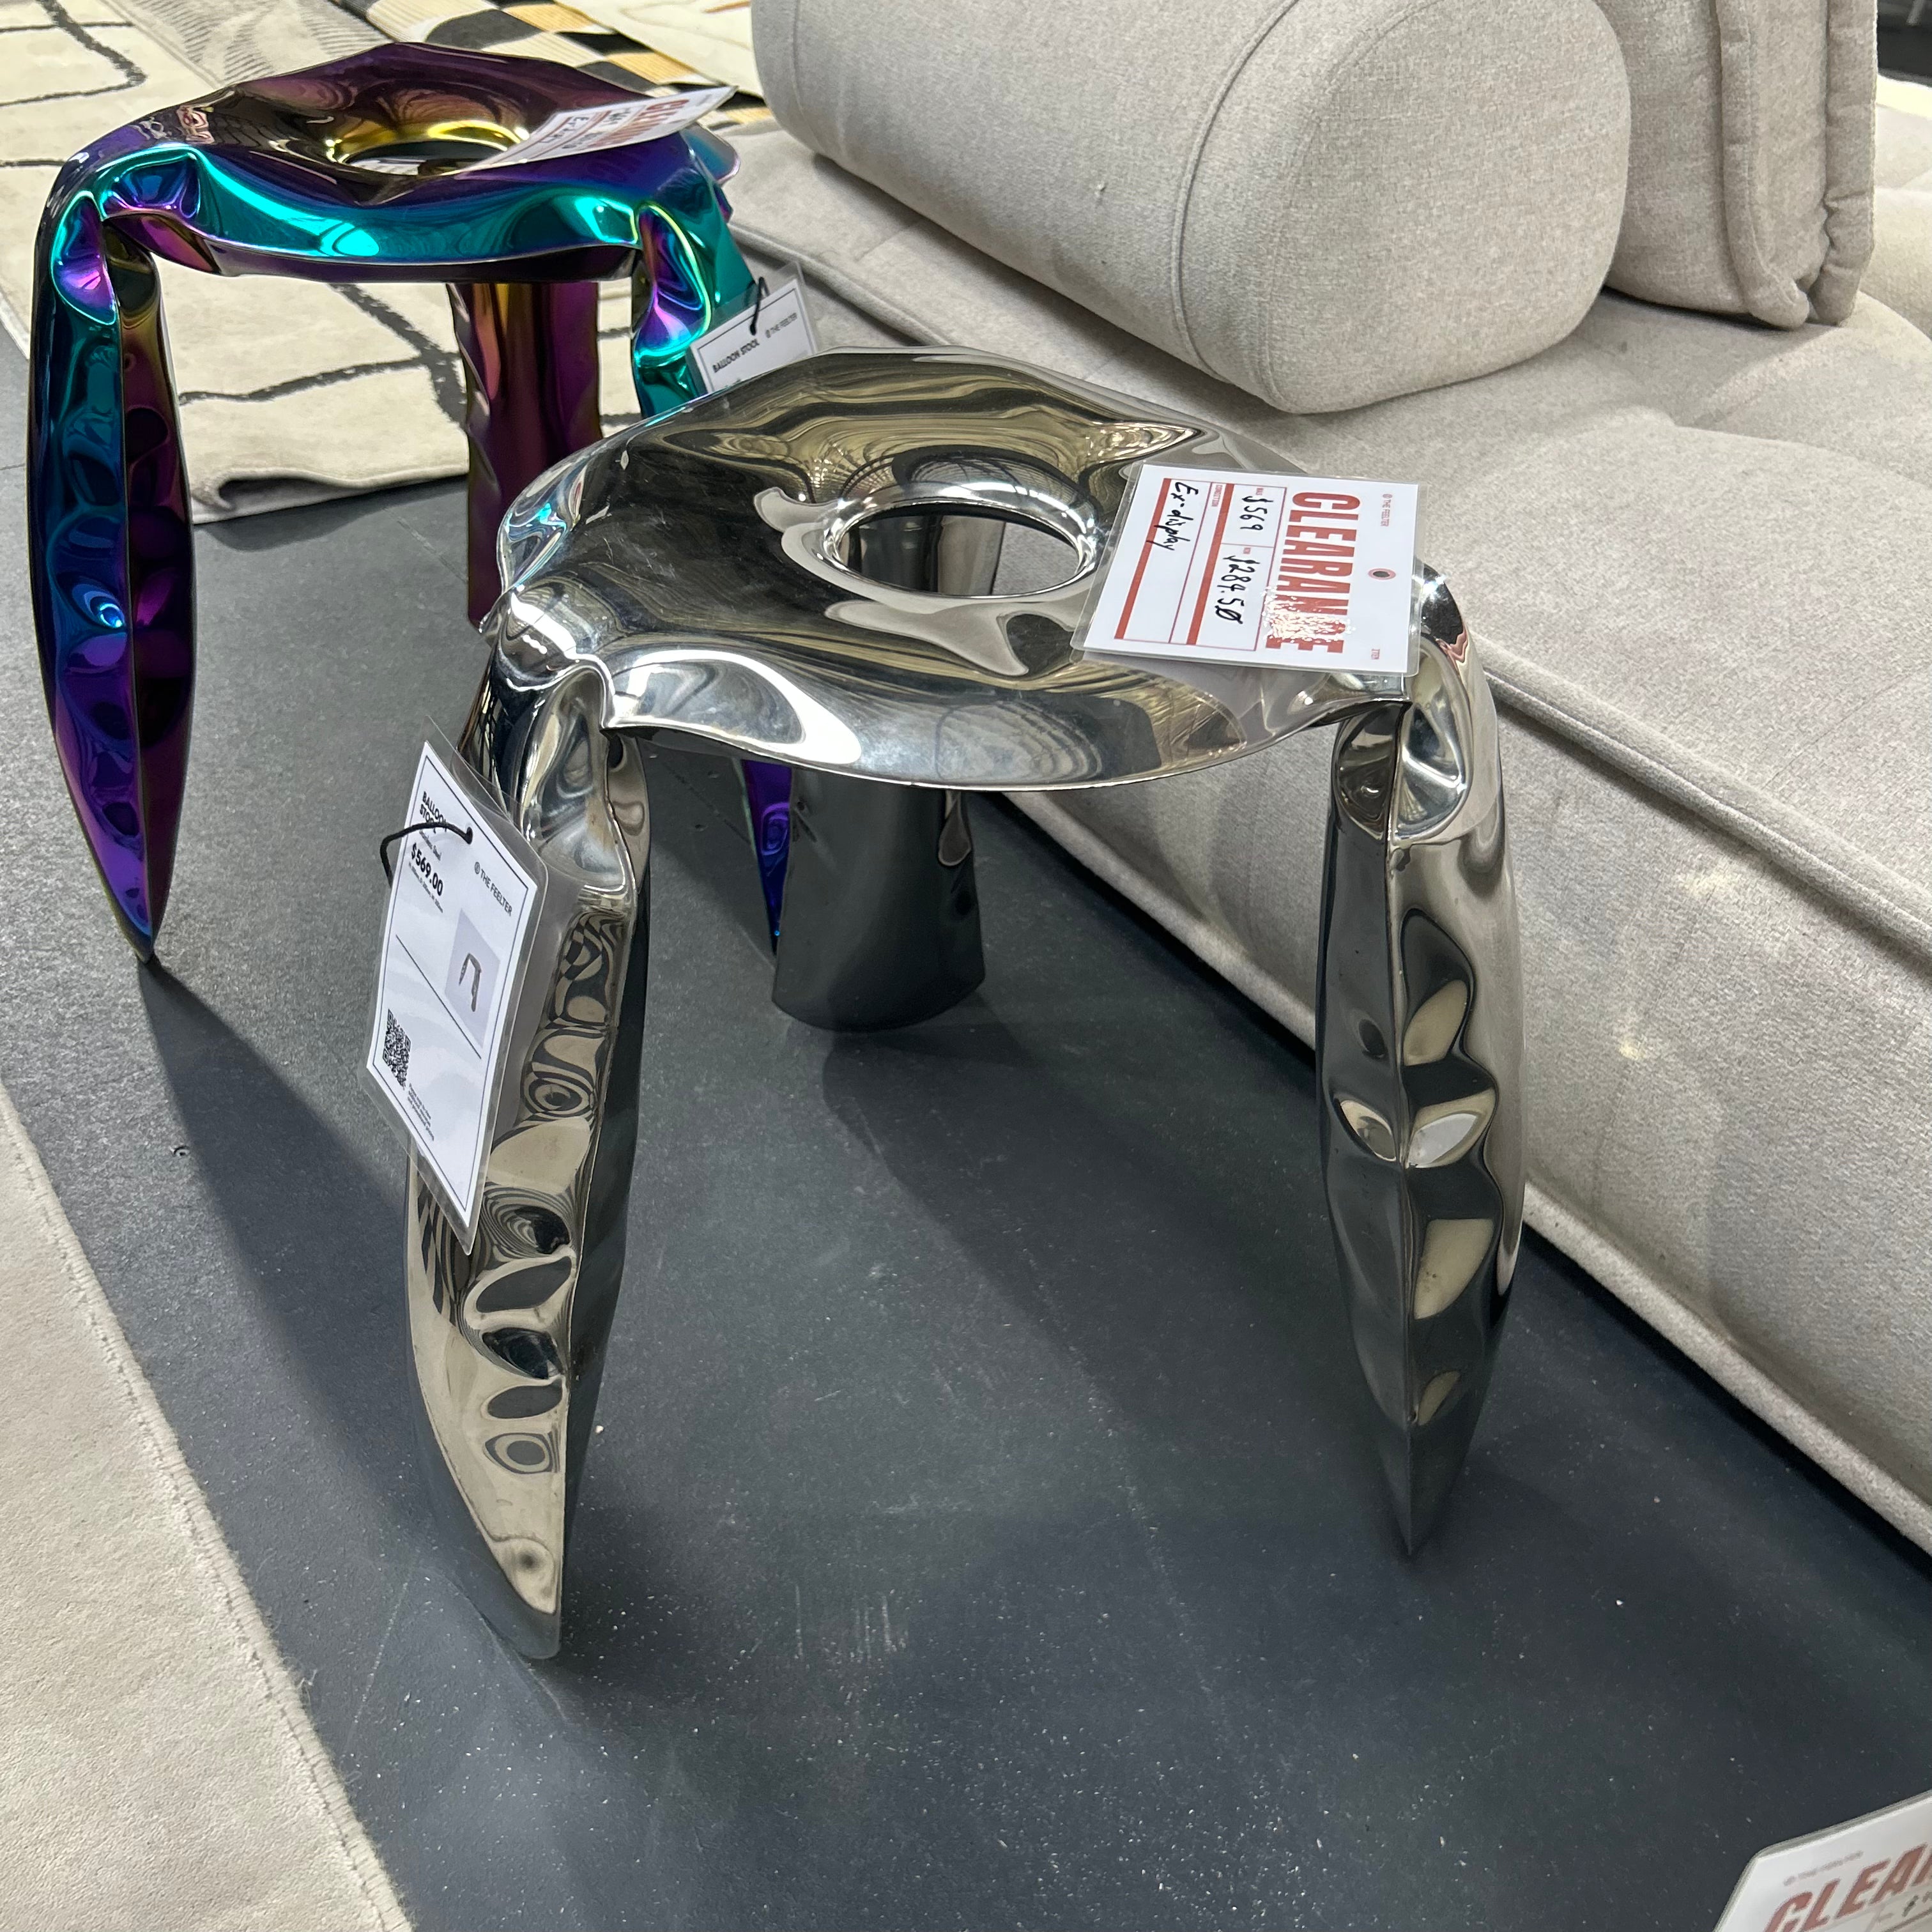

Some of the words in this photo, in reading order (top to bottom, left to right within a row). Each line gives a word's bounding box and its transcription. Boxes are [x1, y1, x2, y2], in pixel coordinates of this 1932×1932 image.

[1146, 481, 1199, 551] Ex-display
[1239, 496, 1274, 530] $569
[411, 842, 443, 896] $569.00
[480, 868, 491, 889] THE
[490, 882, 512, 917] FEELTER
